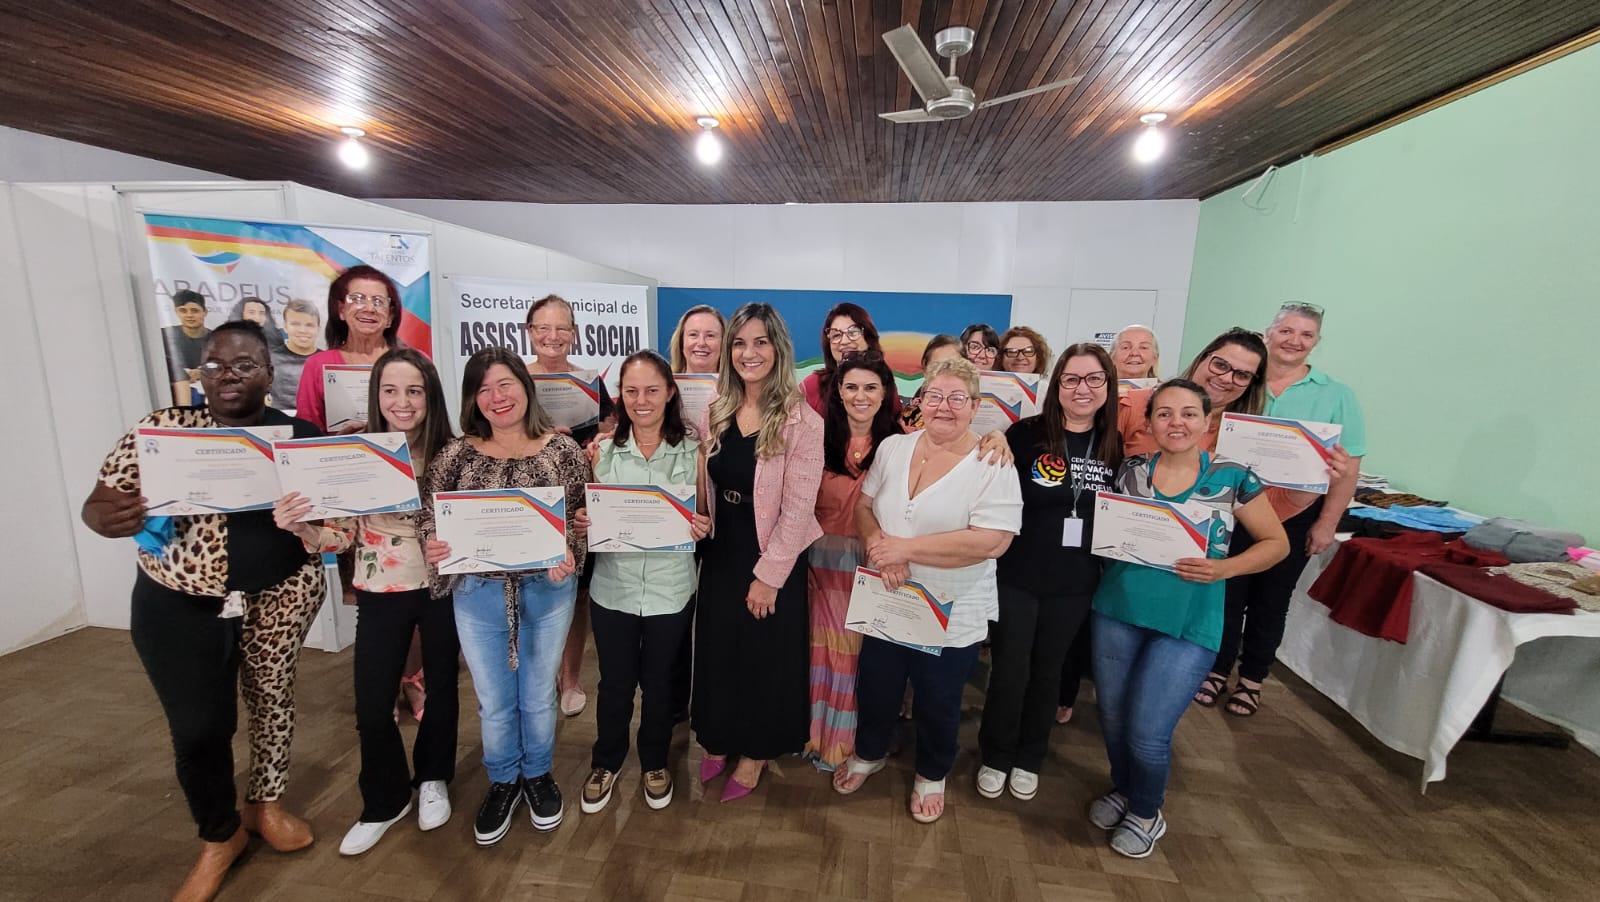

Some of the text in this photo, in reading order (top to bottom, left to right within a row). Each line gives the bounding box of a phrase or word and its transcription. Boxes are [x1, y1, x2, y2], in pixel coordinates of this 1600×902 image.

[460, 293, 638, 316] Secretari nicipal de
[460, 321, 582, 356] ASSISTA
[195, 447, 247, 456] CERTIFICADO
[481, 506, 525, 514] CERTIFICADO
